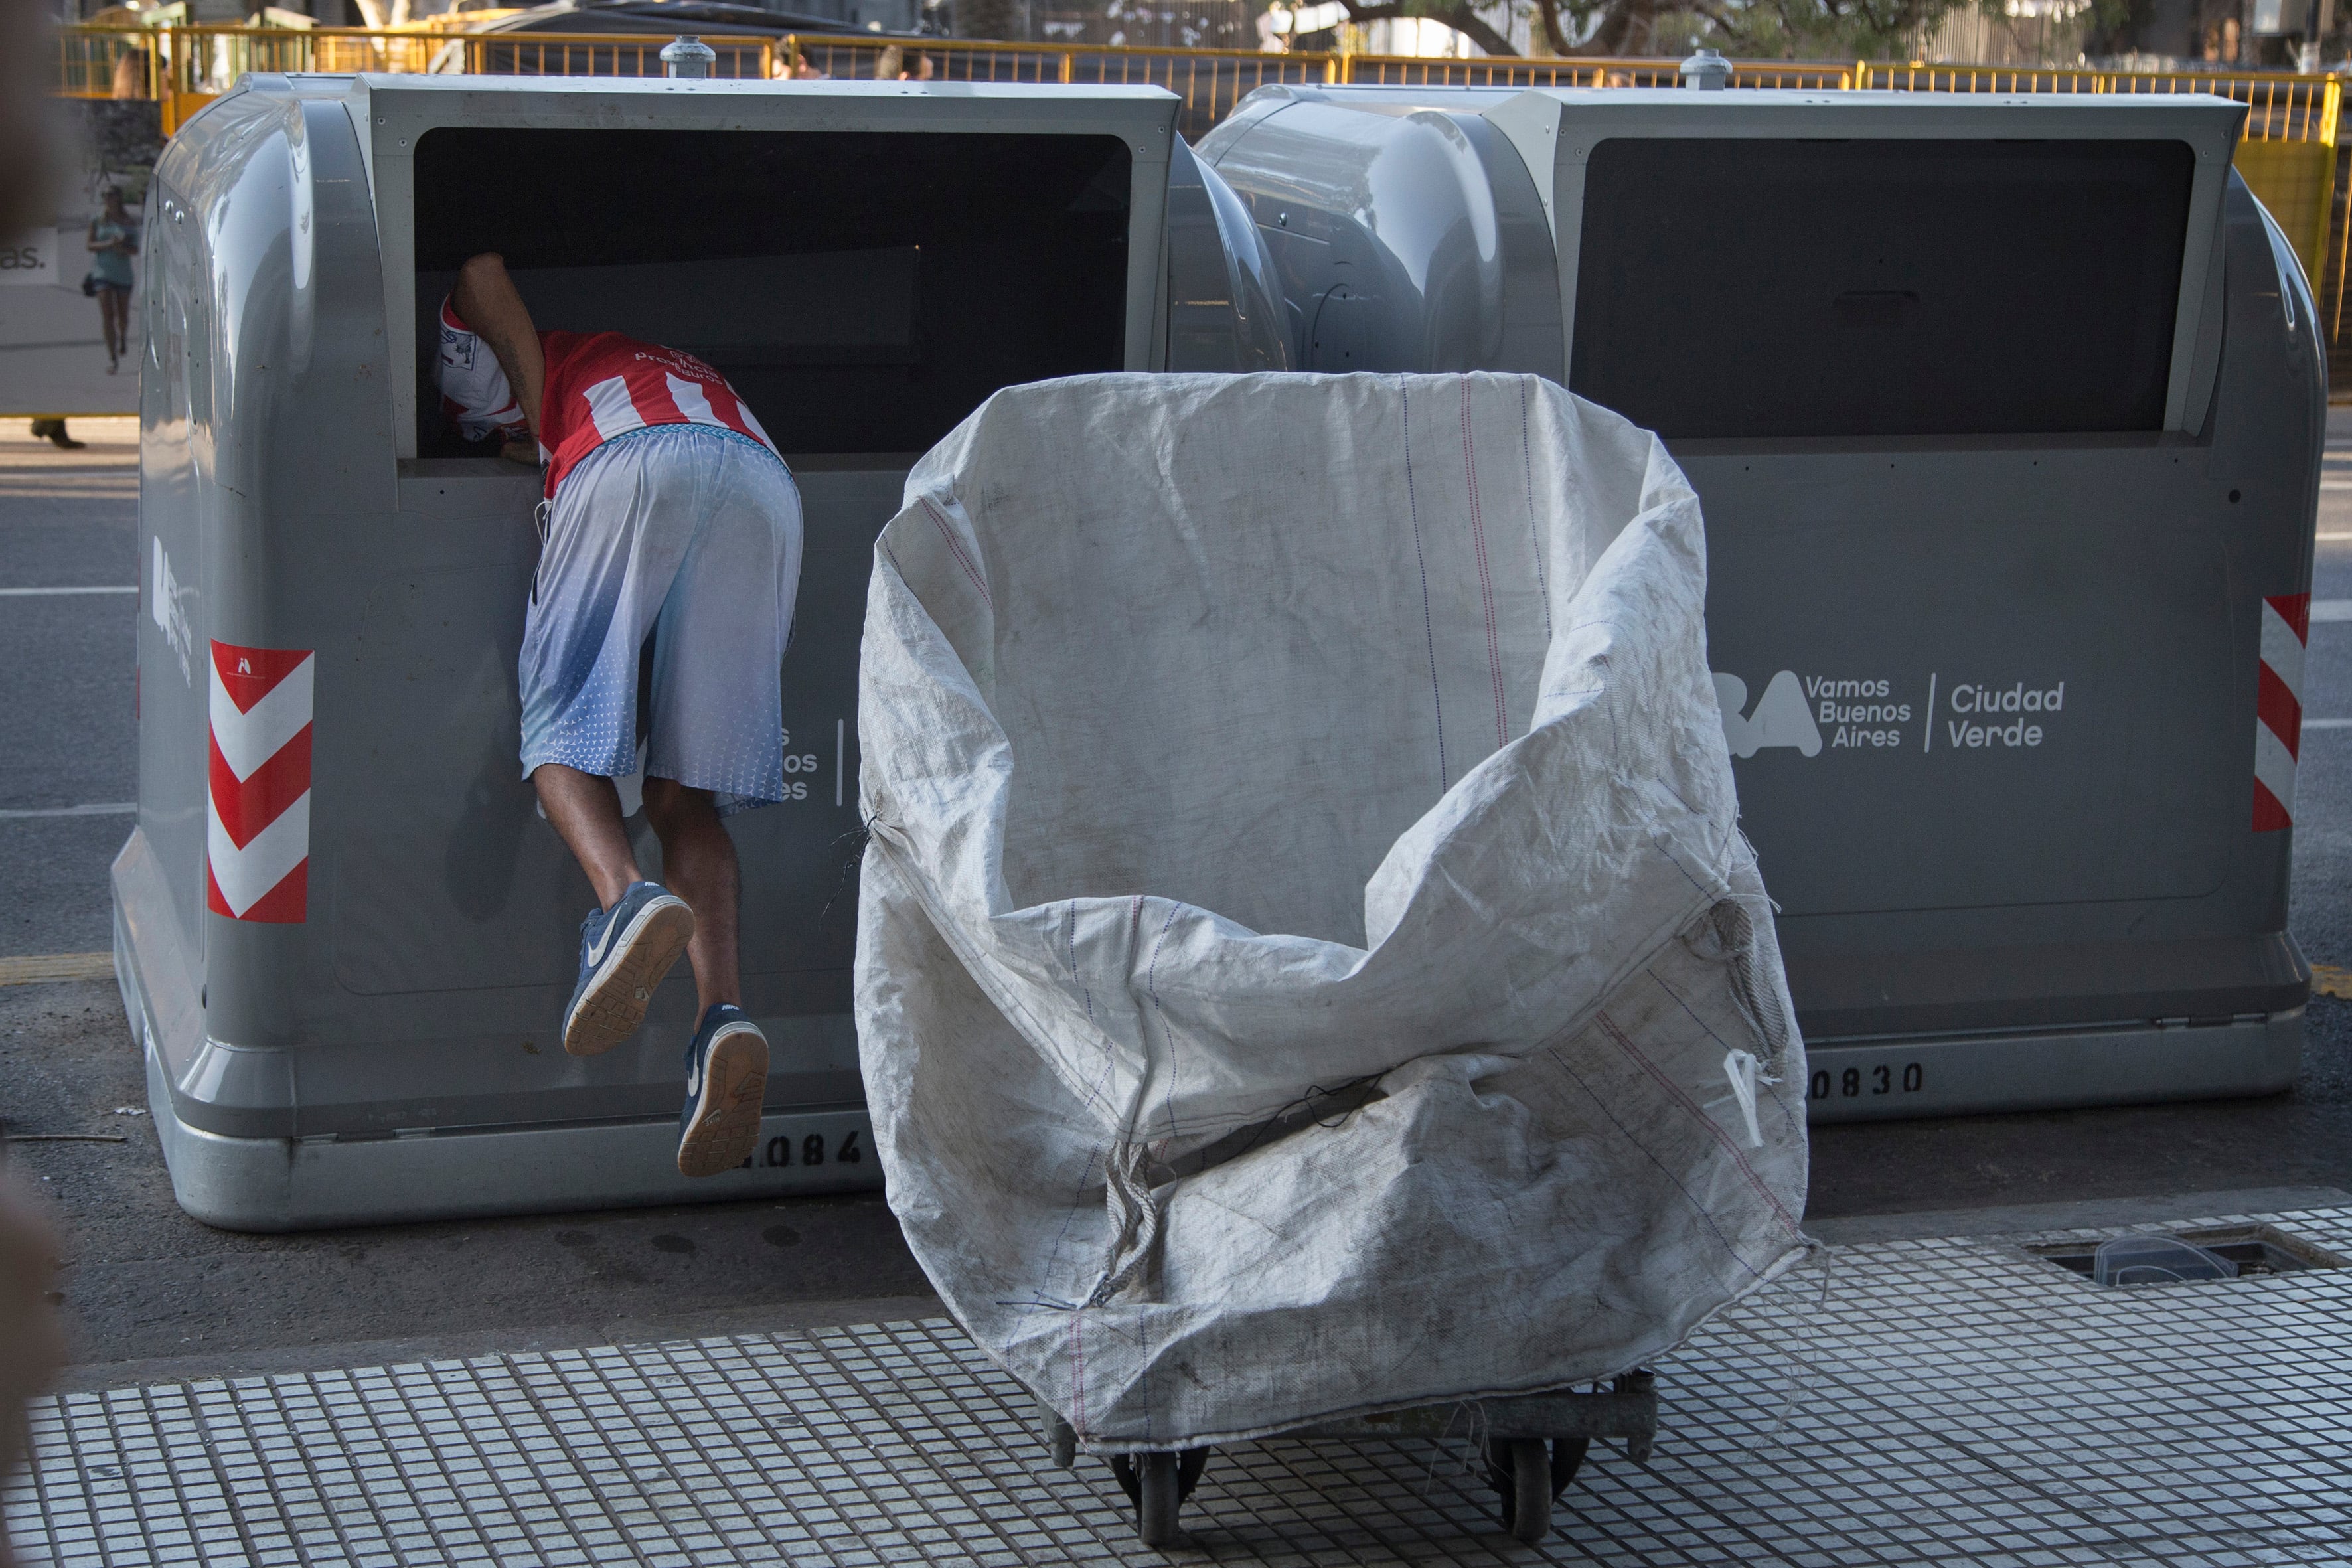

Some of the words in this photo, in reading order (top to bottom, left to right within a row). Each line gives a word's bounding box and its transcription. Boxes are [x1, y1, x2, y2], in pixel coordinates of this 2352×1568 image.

[674, 363, 721, 385] eguros
[1806, 676, 1889, 698] Vamos
[1950, 681, 2065, 713] Ciudad
[1819, 700, 1911, 724] Buenos
[1831, 725, 1901, 748] Aires
[1948, 717, 2043, 748] Verde
[1811, 1062, 1922, 1099] 0830
[733, 1131, 861, 1169] 084
